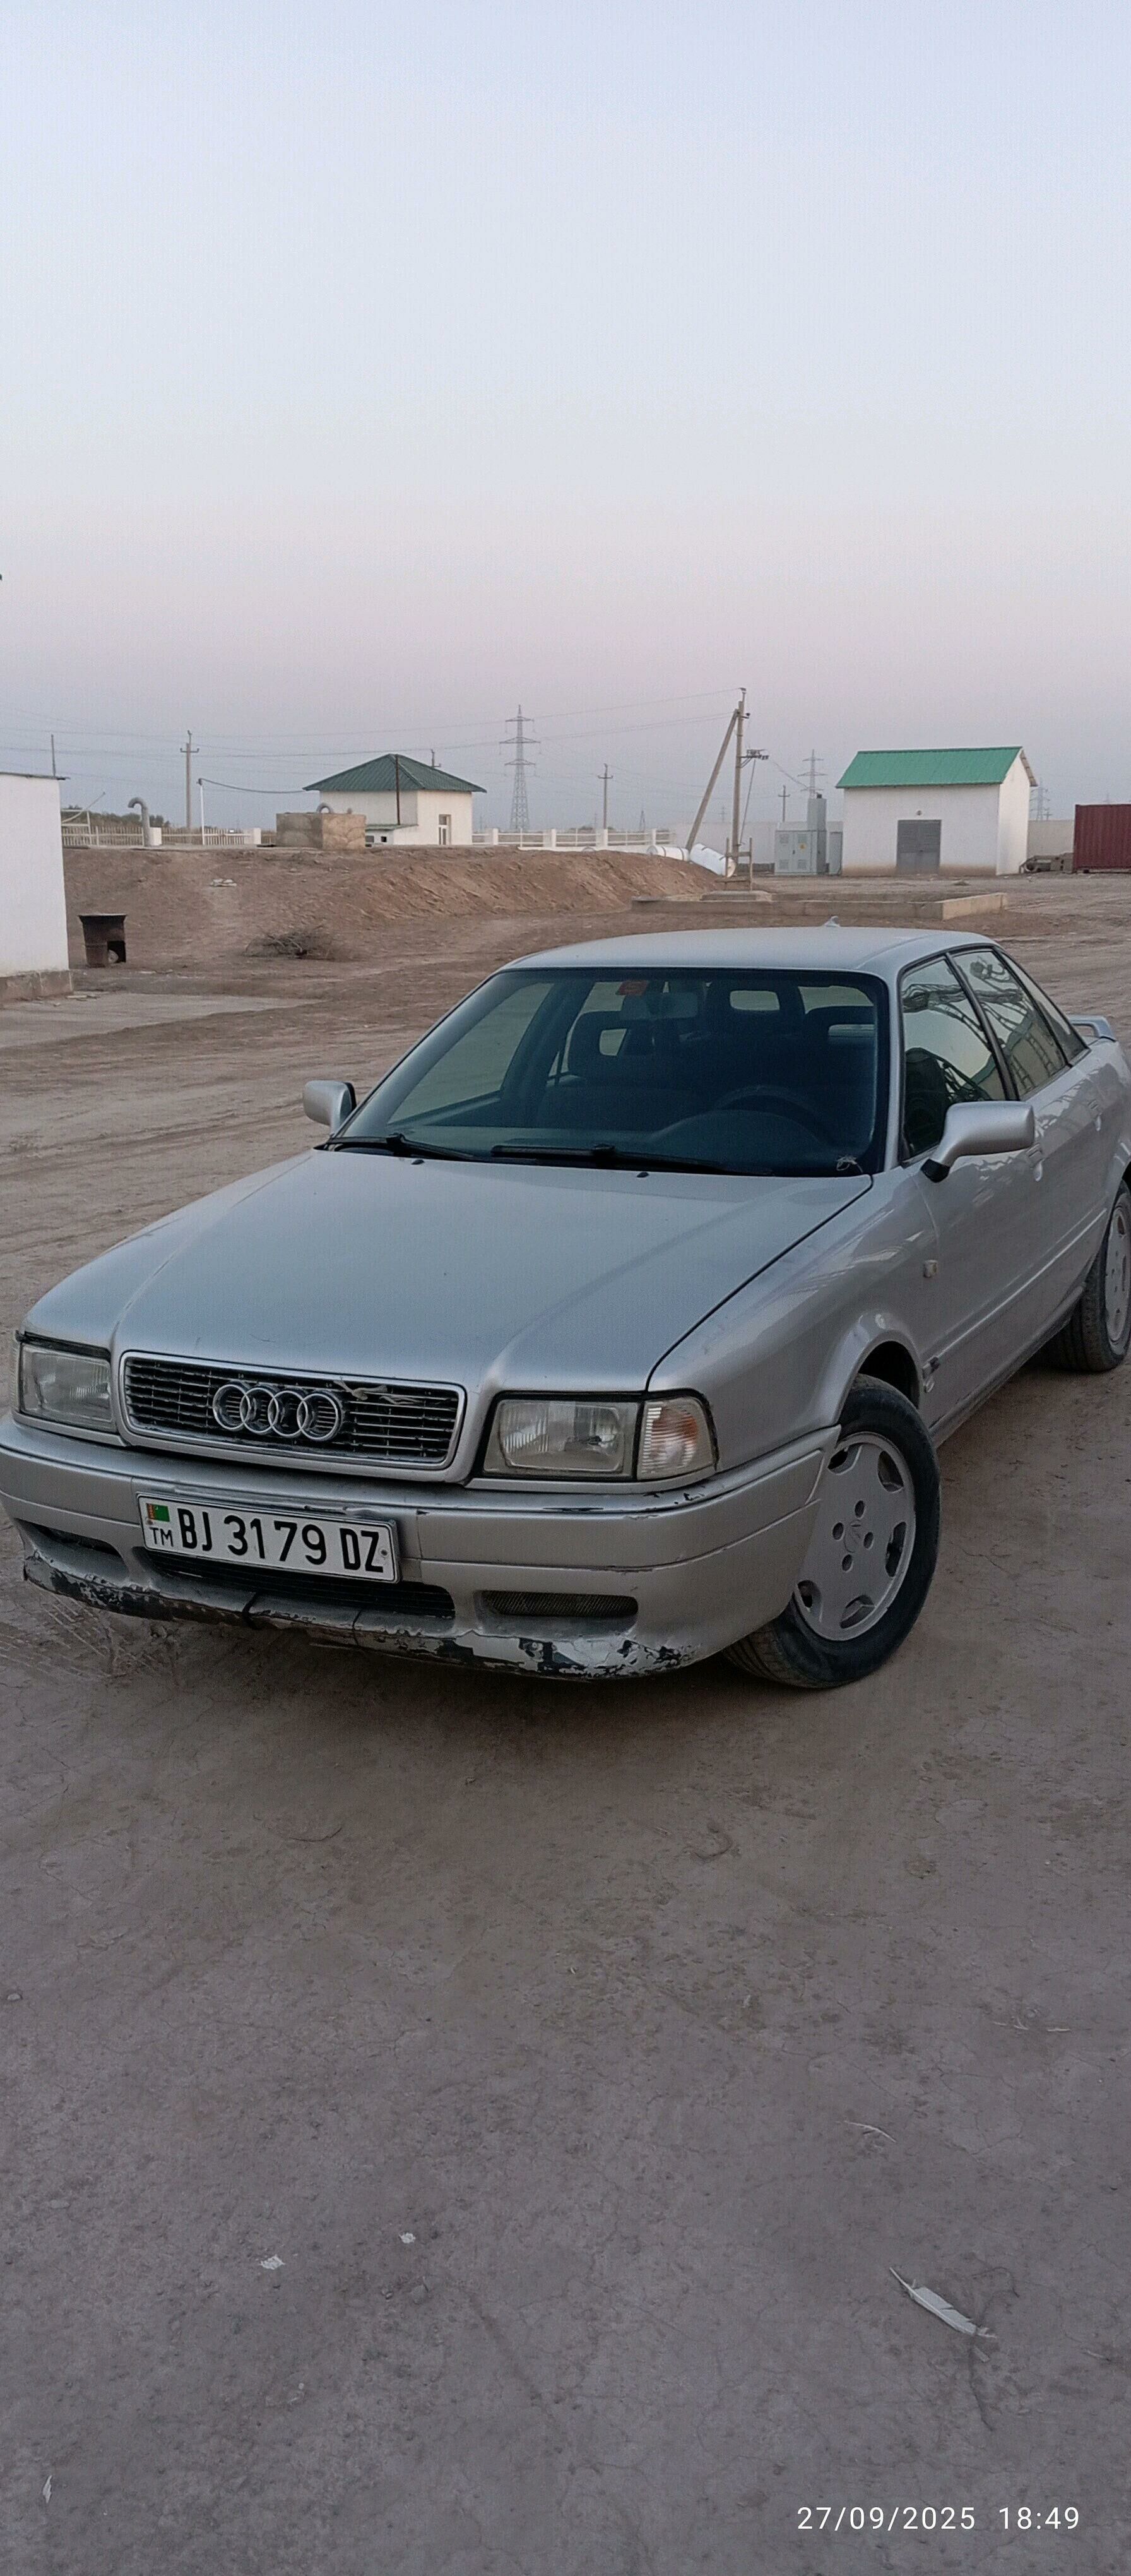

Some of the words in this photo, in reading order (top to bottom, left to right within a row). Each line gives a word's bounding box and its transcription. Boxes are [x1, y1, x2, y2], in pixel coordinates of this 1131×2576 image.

[150, 1527, 174, 1547] TM
[177, 1508, 213, 1551] BJ
[224, 1515, 328, 1565] 3179
[340, 1528, 383, 1573] DZ
